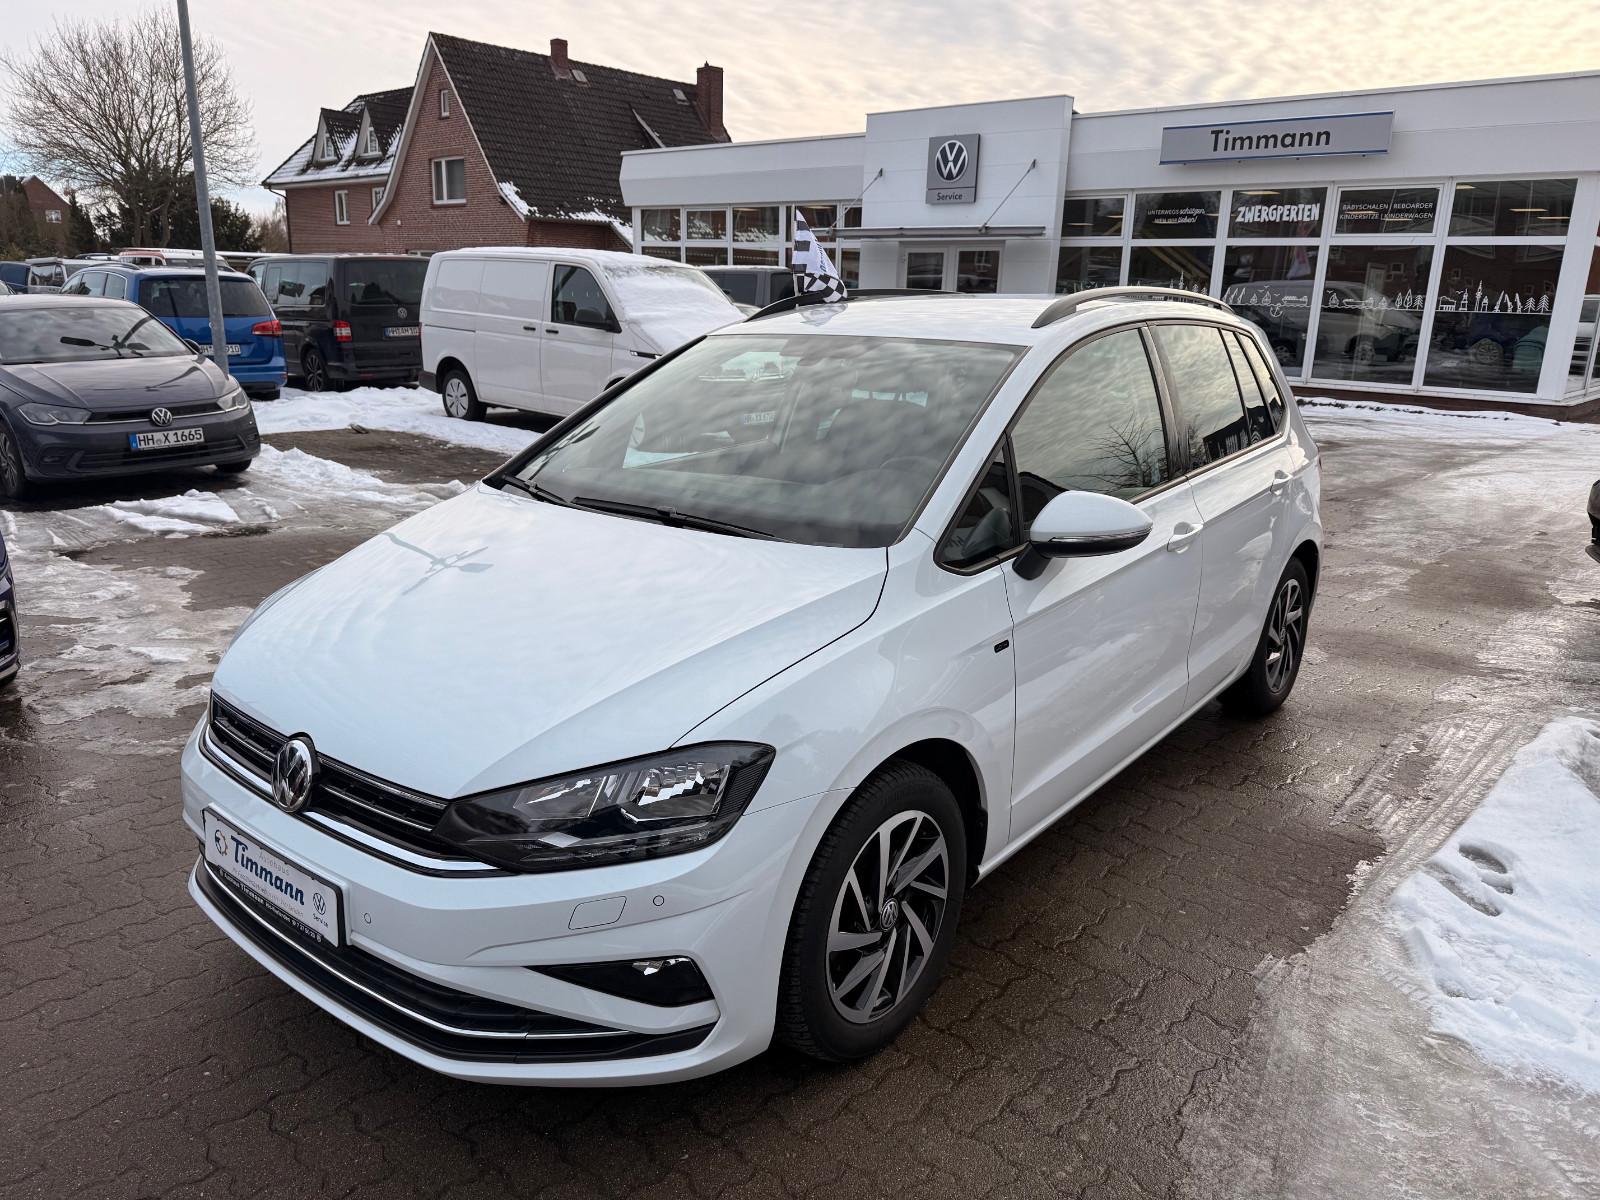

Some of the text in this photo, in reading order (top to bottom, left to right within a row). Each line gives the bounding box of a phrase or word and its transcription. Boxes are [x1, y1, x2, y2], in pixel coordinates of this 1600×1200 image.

[1210, 129, 1331, 152] Timmann
[936, 191, 963, 201] Service
[1235, 203, 1320, 223] ZWERGPERTEN
[137, 434, 155, 447] HH
[162, 433, 171, 444] X
[173, 430, 202, 443] 1665
[231, 836, 305, 905] Timmann
